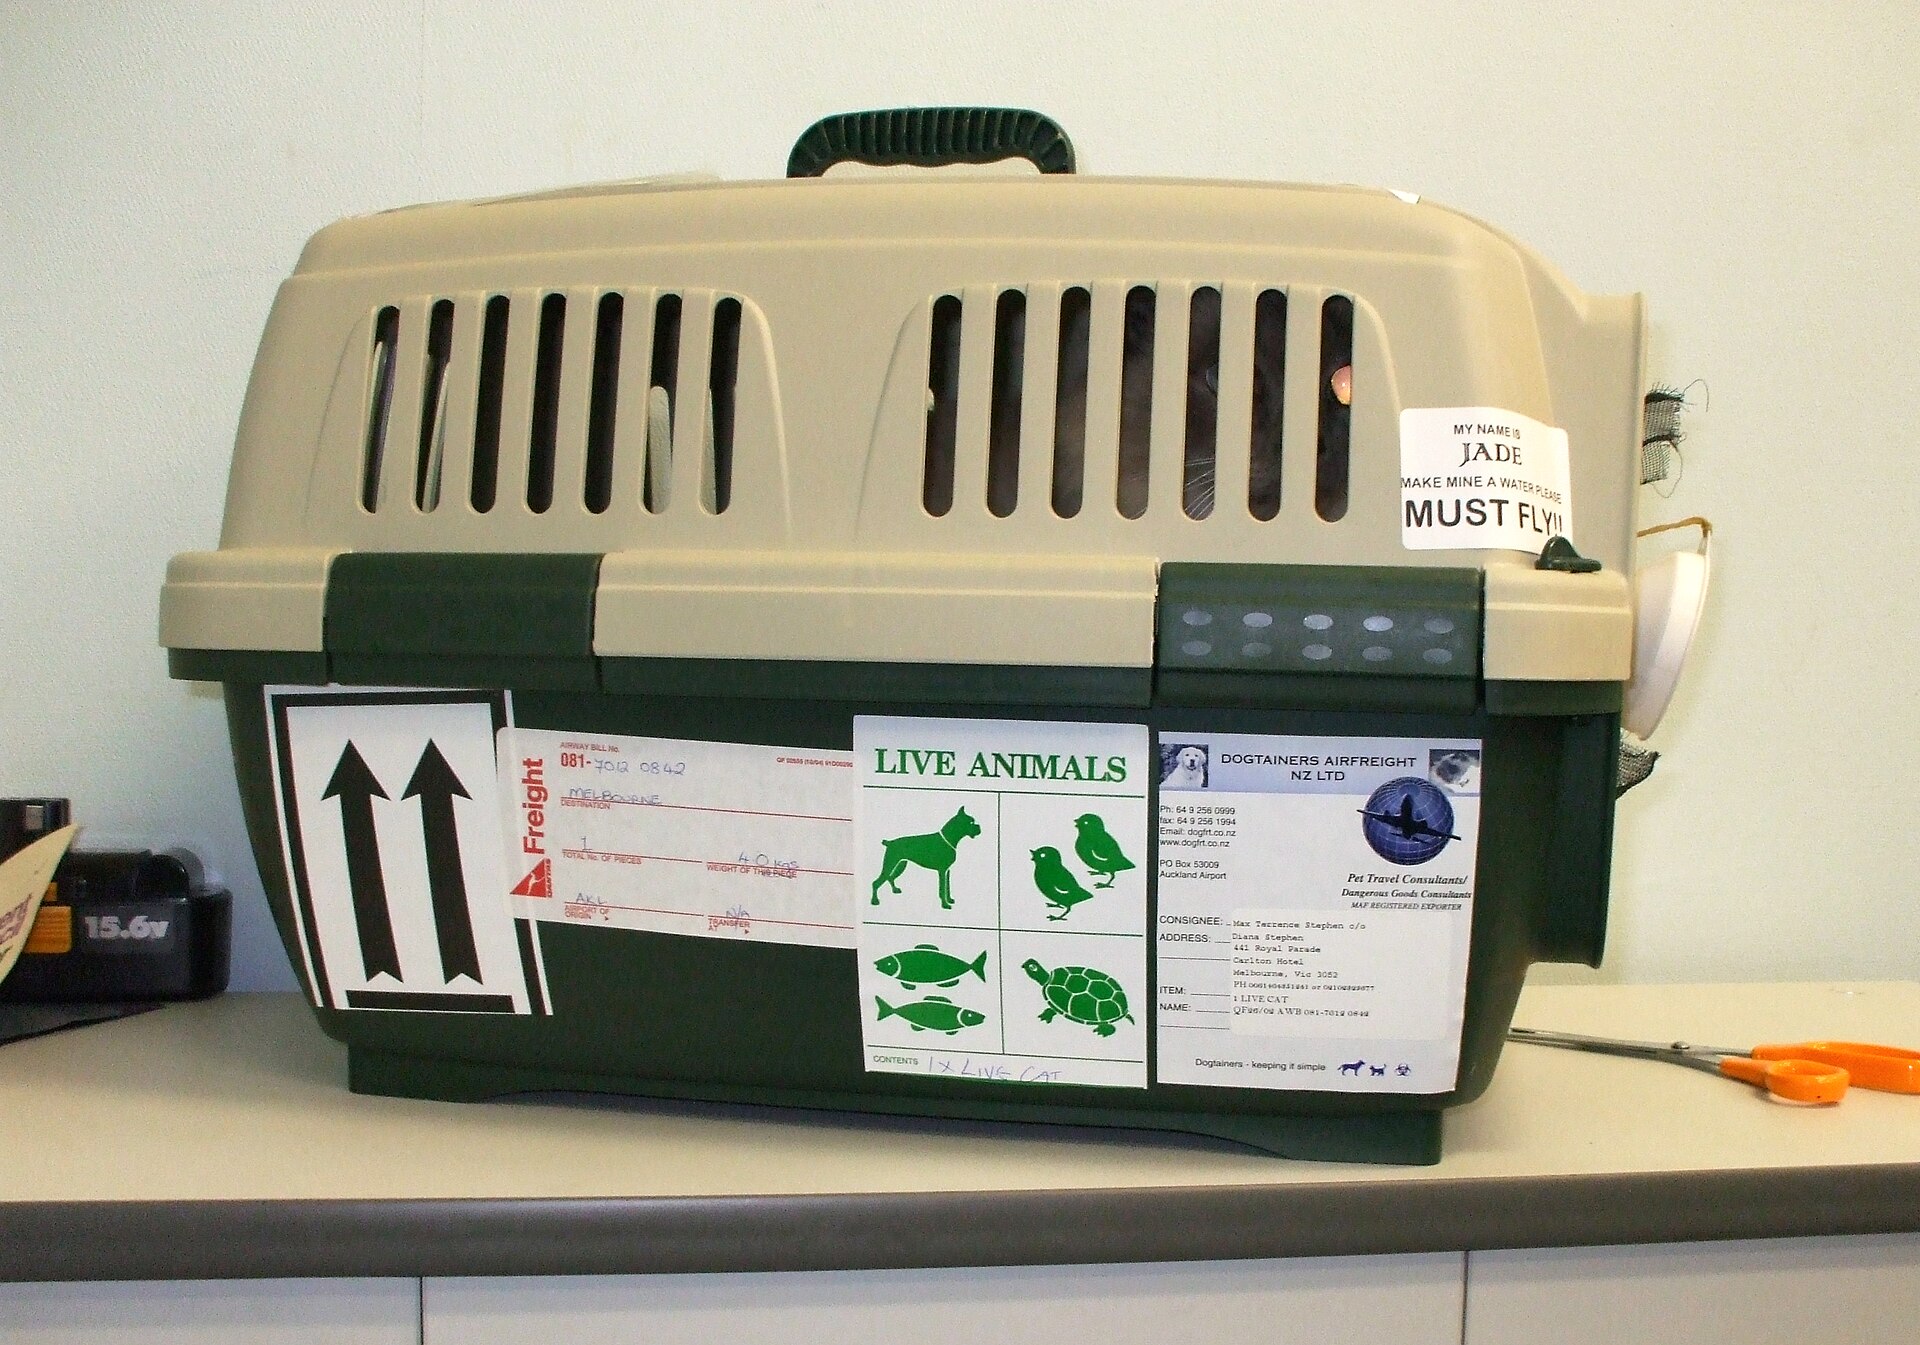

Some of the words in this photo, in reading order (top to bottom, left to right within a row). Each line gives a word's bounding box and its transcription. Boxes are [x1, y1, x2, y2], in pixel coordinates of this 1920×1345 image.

[1454, 424, 1473, 435] MY
[1477, 424, 1510, 437] NAME
[1513, 428, 1521, 439] IS
[1458, 442, 1522, 467] JADE
[1400, 476, 1441, 488] MAKE
[1446, 476, 1483, 487] MINE
[1487, 476, 1496, 487] A
[1500, 477, 1534, 495] WATER
[1535, 484, 1562, 504] PLEASE
[1405, 499, 1509, 527] MUST
[560, 742, 589, 750] AIRWAY
[591, 744, 607, 752] BILL
[874, 748, 956, 776] LIVE
[967, 752, 1127, 783] ANIMALS
[1221, 754, 1319, 766] DOGTAINERS
[1325, 756, 1416, 767] AIRFREIGHT
[640, 760, 686, 776] 0842
[1291, 771, 1311, 781] NZ
[1318, 771, 1345, 781] LTD
[569, 788, 662, 805] MELBOURNE
[522, 757, 549, 855] Freight
[560, 800, 611, 810] DESTINATION
[1160, 805, 1174, 813] Ph:
[1215, 807, 1235, 815] 0999
[1160, 827, 1185, 835] Email:
[1188, 828, 1236, 838] dogfrt.co.nz
[1160, 839, 1230, 848] www.dogfrt.co.nz
[563, 852, 584, 860] TOTAL
[614, 857, 642, 865] PIECES
[707, 864, 737, 873] WEIGHT
[740, 866, 751, 874] OF
[1160, 860, 1172, 868] PO
[1176, 860, 1191, 868] Box
[1159, 871, 1197, 879] Auckland
[1199, 872, 1226, 880] Airport
[1347, 873, 1364, 883] Pet
[1367, 874, 1399, 884] Travel
[1402, 874, 1468, 884] Consultants/
[1341, 888, 1388, 899] Dangerous
[1391, 889, 1418, 898] Goods
[1421, 890, 1472, 899] Consultants
[565, 905, 596, 913] AIRPORT
[600, 906, 609, 914] OF
[1370, 902, 1419, 910] REGISTERED
[1421, 903, 1461, 911] EXPORTER
[565, 911, 592, 919] ORIGIN
[1159, 915, 1223, 925] CONSIGNEE:
[708, 918, 751, 928] TRANSFER
[1256, 920, 1300, 928] Terrence
[1305, 921, 1344, 930] Stephen
[1349, 922, 1366, 930] c/o
[1159, 933, 1211, 942] ADDRESS:
[1232, 932, 1259, 940] Diana
[1265, 934, 1304, 942] Stephen
[1255, 945, 1282, 953] Royal
[1288, 945, 1321, 953] Parade
[1233, 970, 1288, 978] Melbourne,
[1159, 986, 1186, 994] ITEM:
[1241, 995, 1267, 1003] LIVE
[1159, 1003, 1191, 1011] NAME:
[873, 1055, 919, 1065] CONTENTS
[1195, 1058, 1243, 1068] Dogtainers
[1251, 1060, 1287, 1071] keeping
[1289, 1062, 1294, 1070] it
[1297, 1062, 1326, 1072] simple
